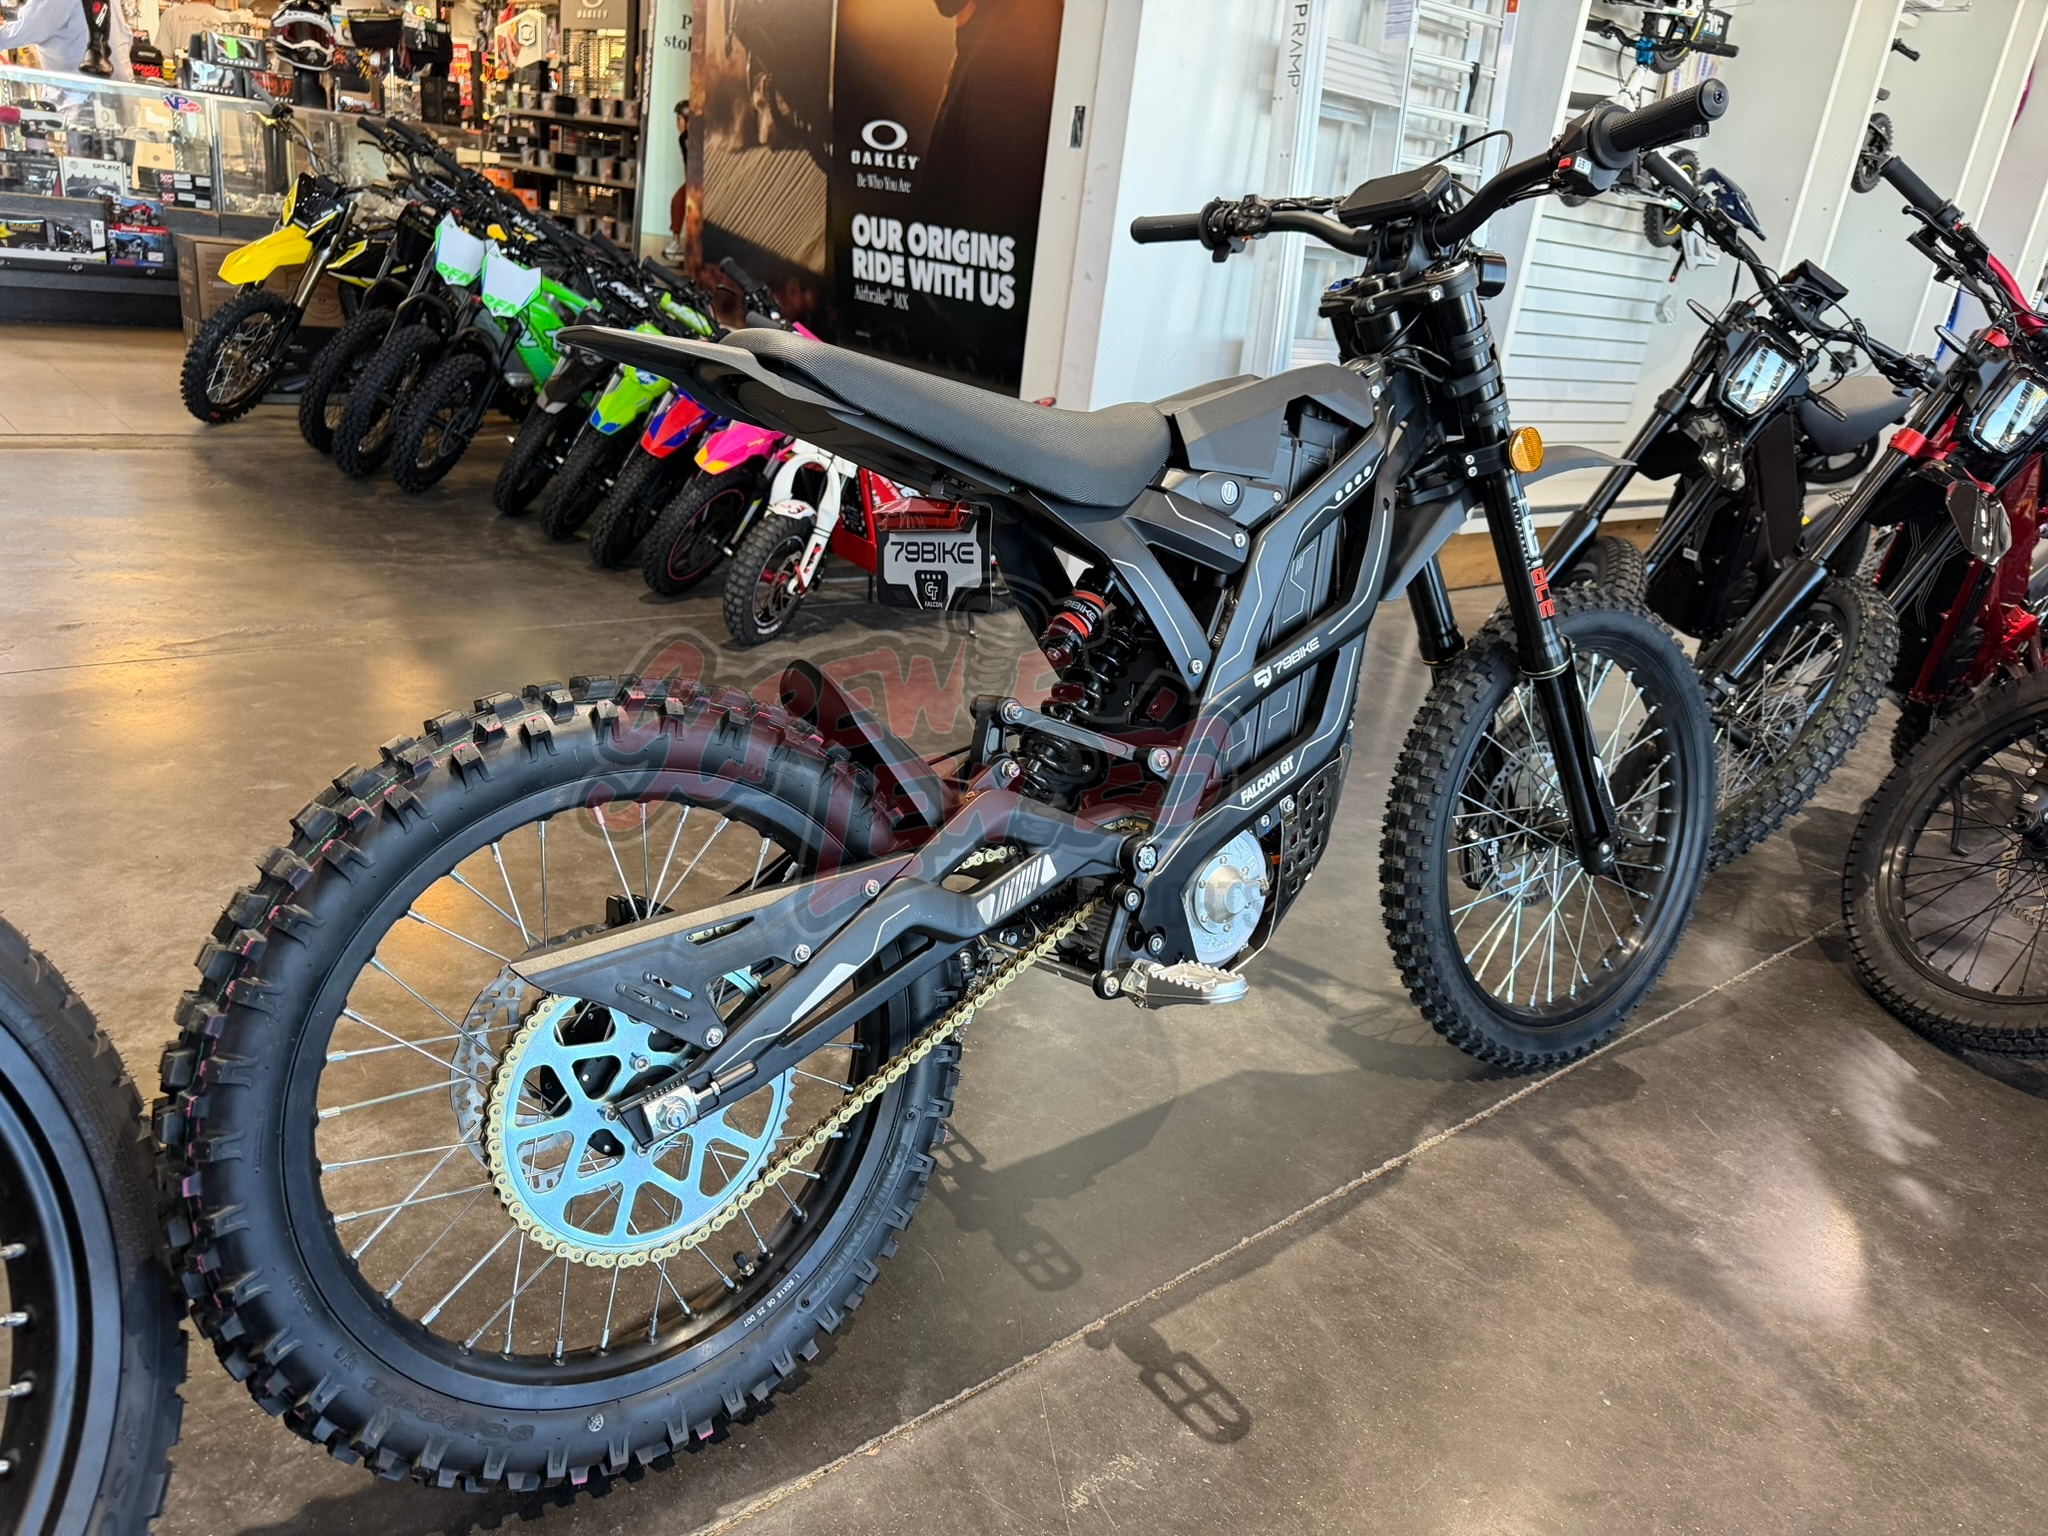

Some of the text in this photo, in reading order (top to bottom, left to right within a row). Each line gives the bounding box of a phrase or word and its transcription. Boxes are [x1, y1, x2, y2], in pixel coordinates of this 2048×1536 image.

[850, 149, 919, 171] OAKLEY
[851, 212, 1016, 273] OUR ORIGINS
[852, 247, 1017, 310] RIDE WITH US
[890, 541, 975, 565] 79BIKE
[1272, 637, 1321, 674] 79BIKE
[1240, 754, 1294, 806] FALCON GT
[743, 1314, 756, 1328] DOT
